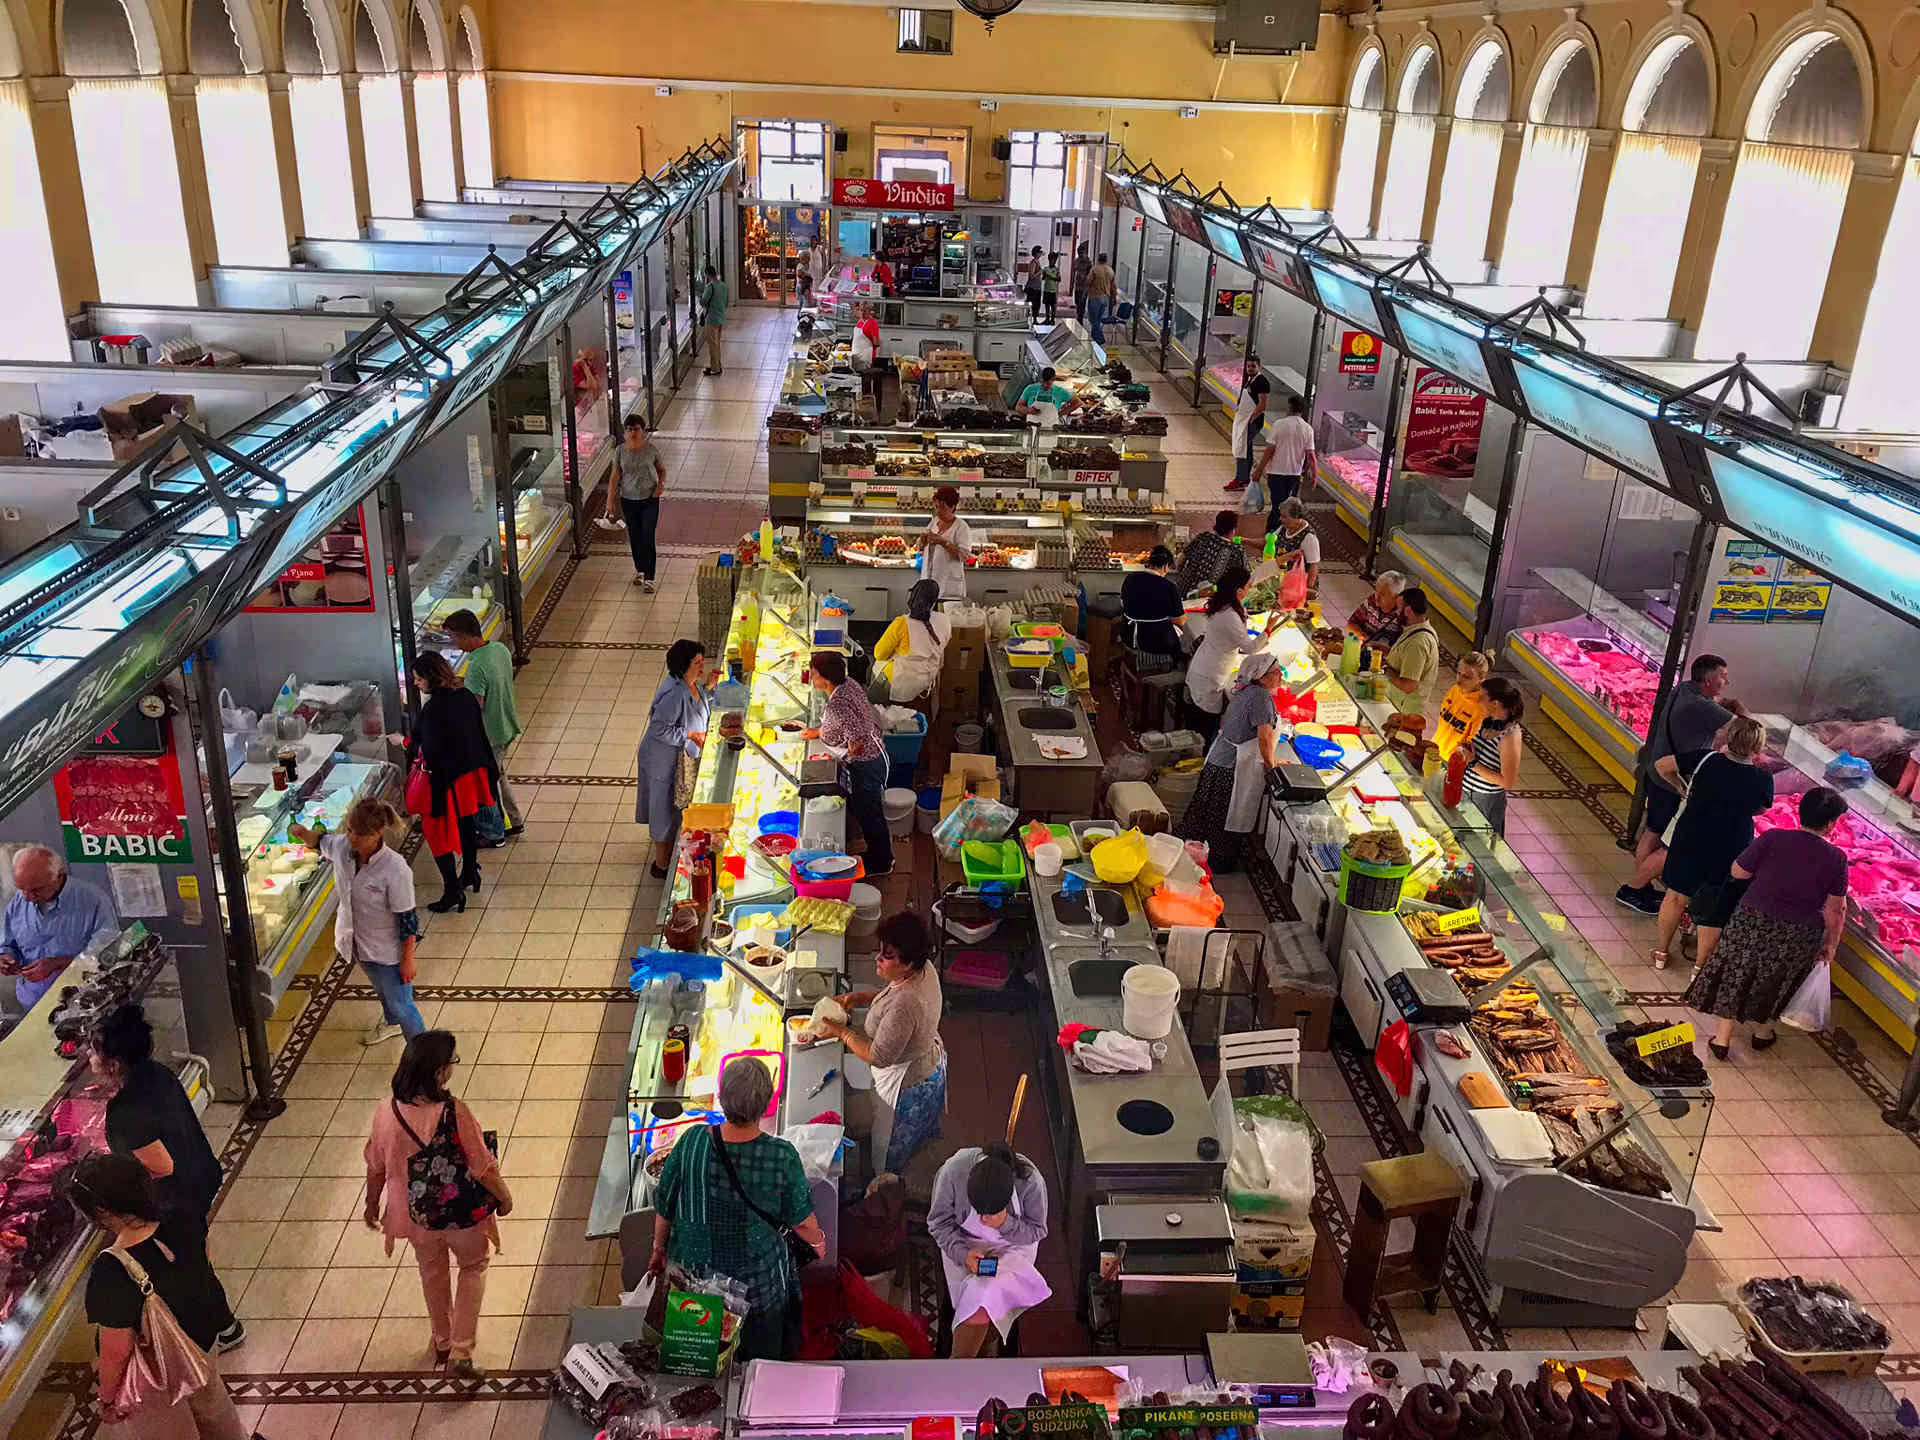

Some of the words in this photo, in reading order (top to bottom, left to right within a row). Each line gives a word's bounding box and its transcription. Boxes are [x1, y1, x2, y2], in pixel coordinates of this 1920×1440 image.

[883, 182, 946, 206] Vindija
[1074, 471, 1113, 483] BIFTEK
[99, 807, 157, 823] Almir
[81, 830, 179, 858] BABIĆ
[1443, 914, 1476, 929] JARETINA
[1650, 1034, 1685, 1052] STELJA
[571, 1358, 601, 1389] JARETINA
[1027, 1406, 1093, 1422] BOSANSKA
[1144, 1410, 1195, 1423] PIKANT
[1199, 1409, 1256, 1423] POSEBNA
